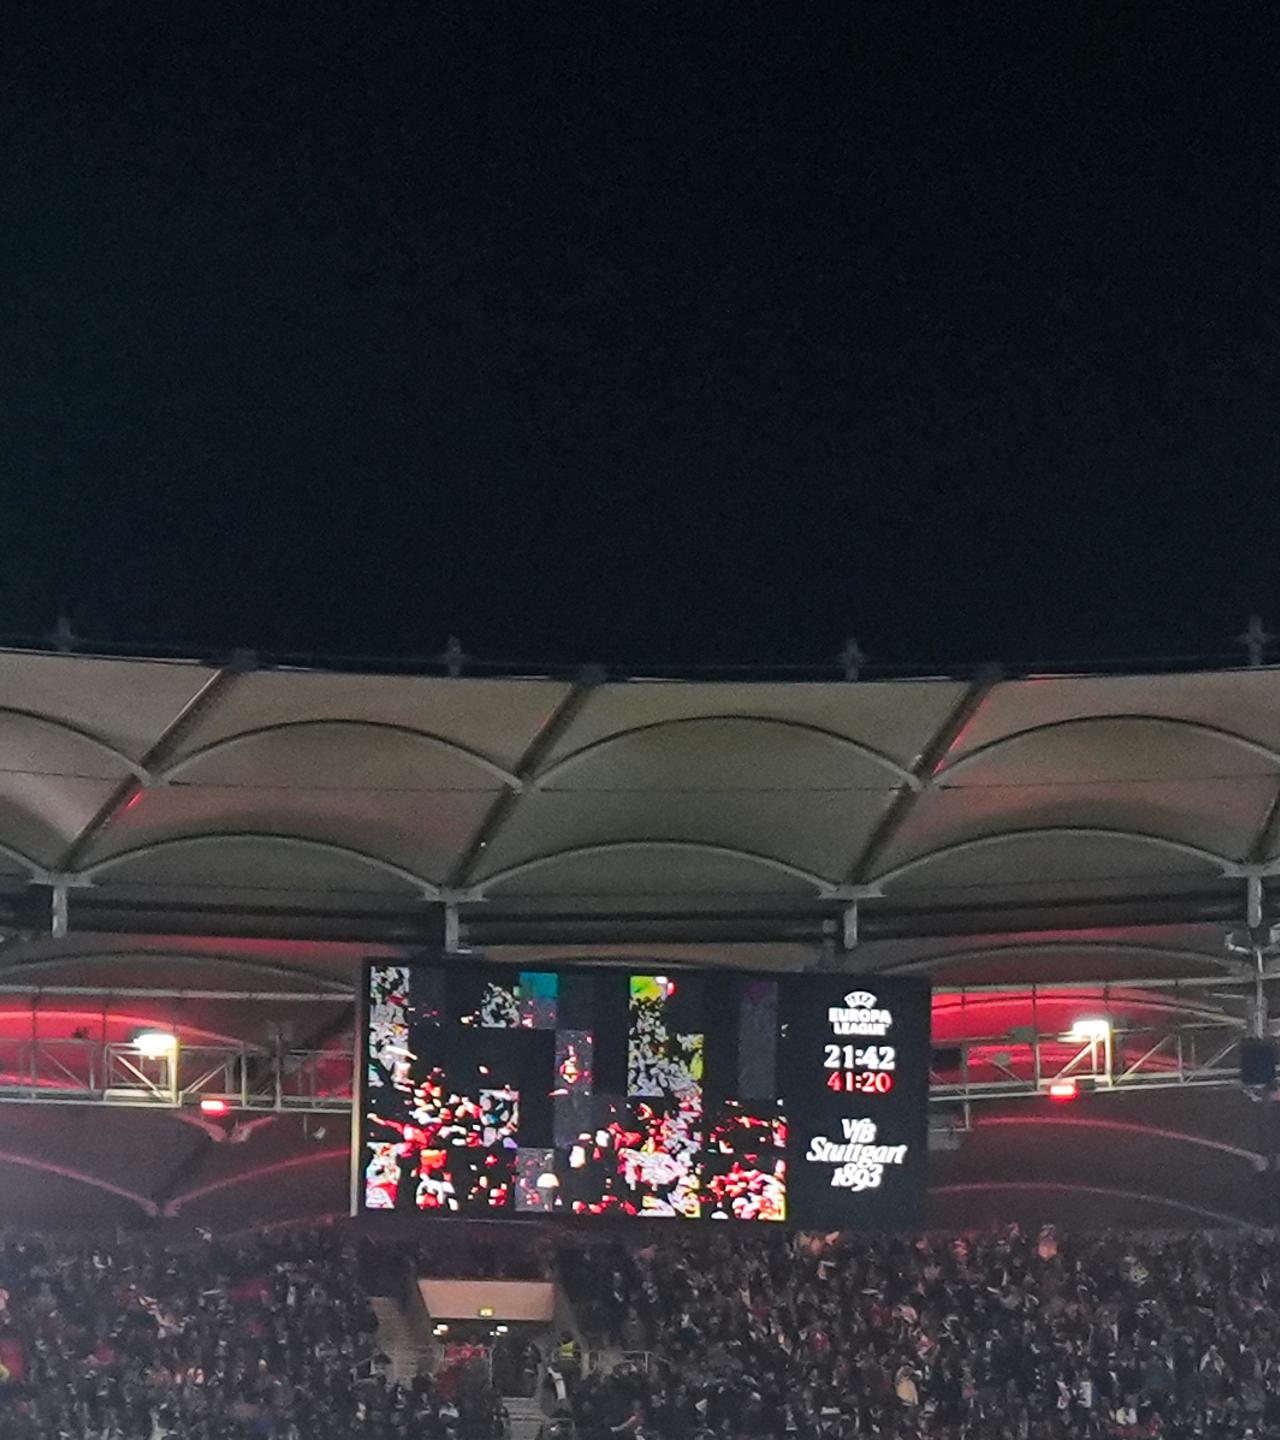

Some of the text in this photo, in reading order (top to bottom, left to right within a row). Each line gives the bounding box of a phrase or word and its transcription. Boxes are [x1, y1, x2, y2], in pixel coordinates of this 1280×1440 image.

[828, 1007, 893, 1025] EUROPA
[833, 1023, 888, 1036] LEAGUE
[824, 1044, 896, 1070] 21:42
[827, 1071, 894, 1093] 41:20
[841, 1117, 878, 1144] VfB
[805, 1136, 908, 1167] Stuttgart
[830, 1163, 884, 1192] 1893
